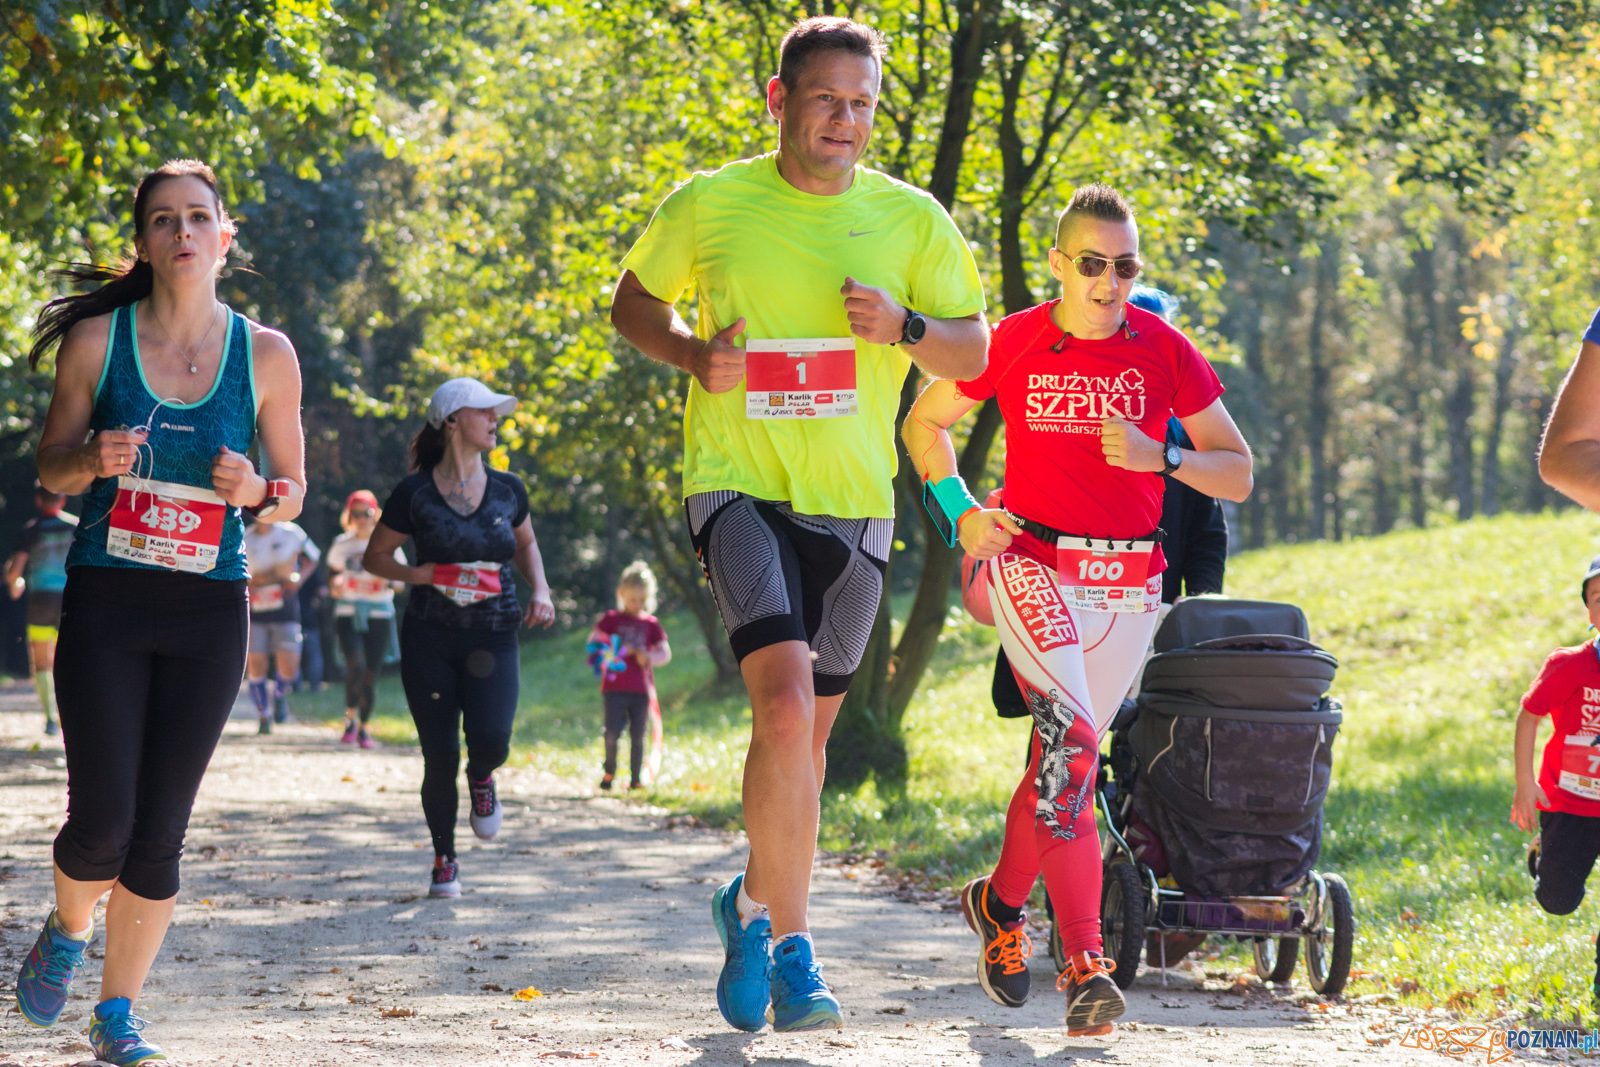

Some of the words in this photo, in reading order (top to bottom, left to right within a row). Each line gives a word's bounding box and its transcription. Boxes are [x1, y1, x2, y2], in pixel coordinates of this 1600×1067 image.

[796, 362, 806, 384] 1
[1027, 371, 1126, 393] DRUŻYNA
[1025, 392, 1146, 420] SZPIKU
[140, 504, 199, 534] 439
[150, 538, 175, 549] Karlik
[1078, 559, 1124, 581] 100
